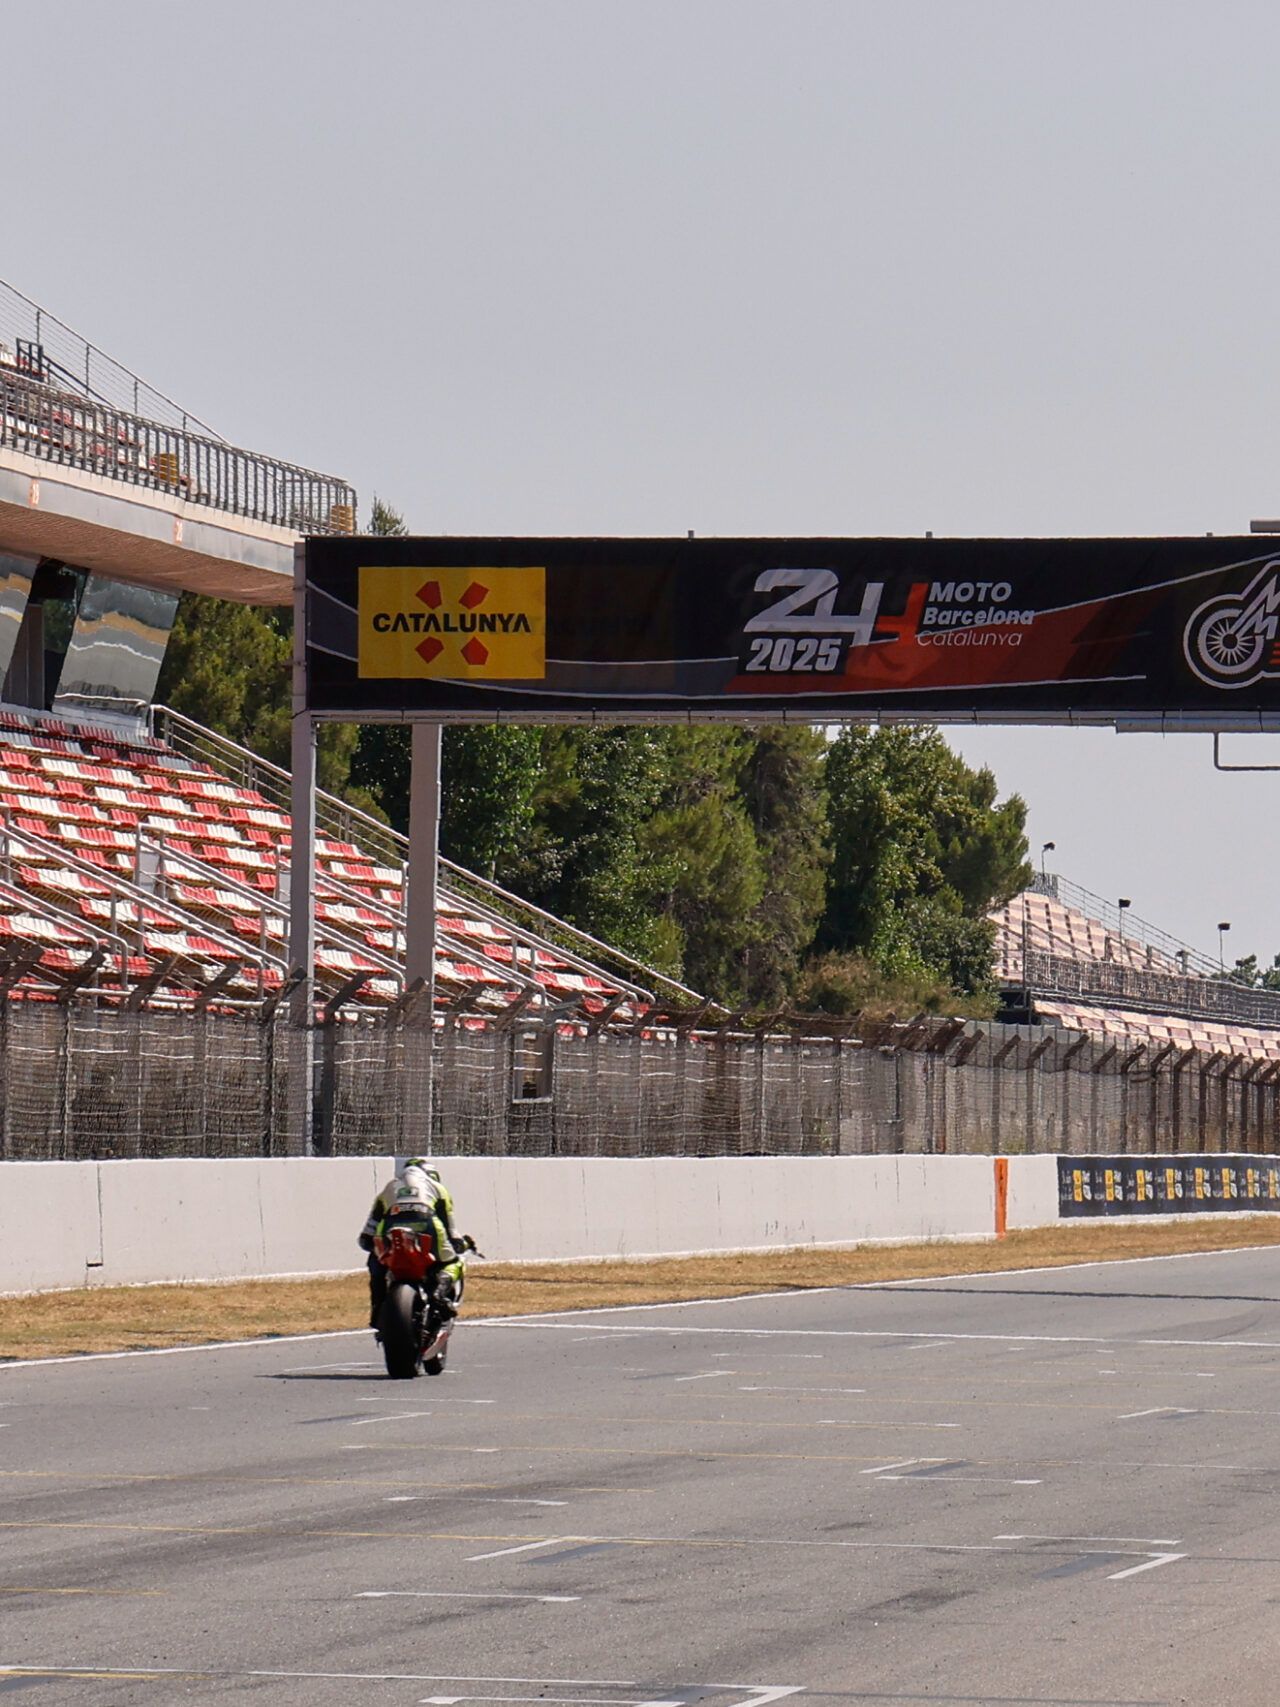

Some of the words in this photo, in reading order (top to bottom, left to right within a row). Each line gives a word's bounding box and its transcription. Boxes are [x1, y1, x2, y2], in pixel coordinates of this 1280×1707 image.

[928, 582, 1012, 602] MOTO
[372, 613, 531, 634] CATALUNYA
[922, 607, 1035, 625] Barcelona
[916, 629, 1023, 647] Catalunya
[746, 638, 842, 671] 2025
